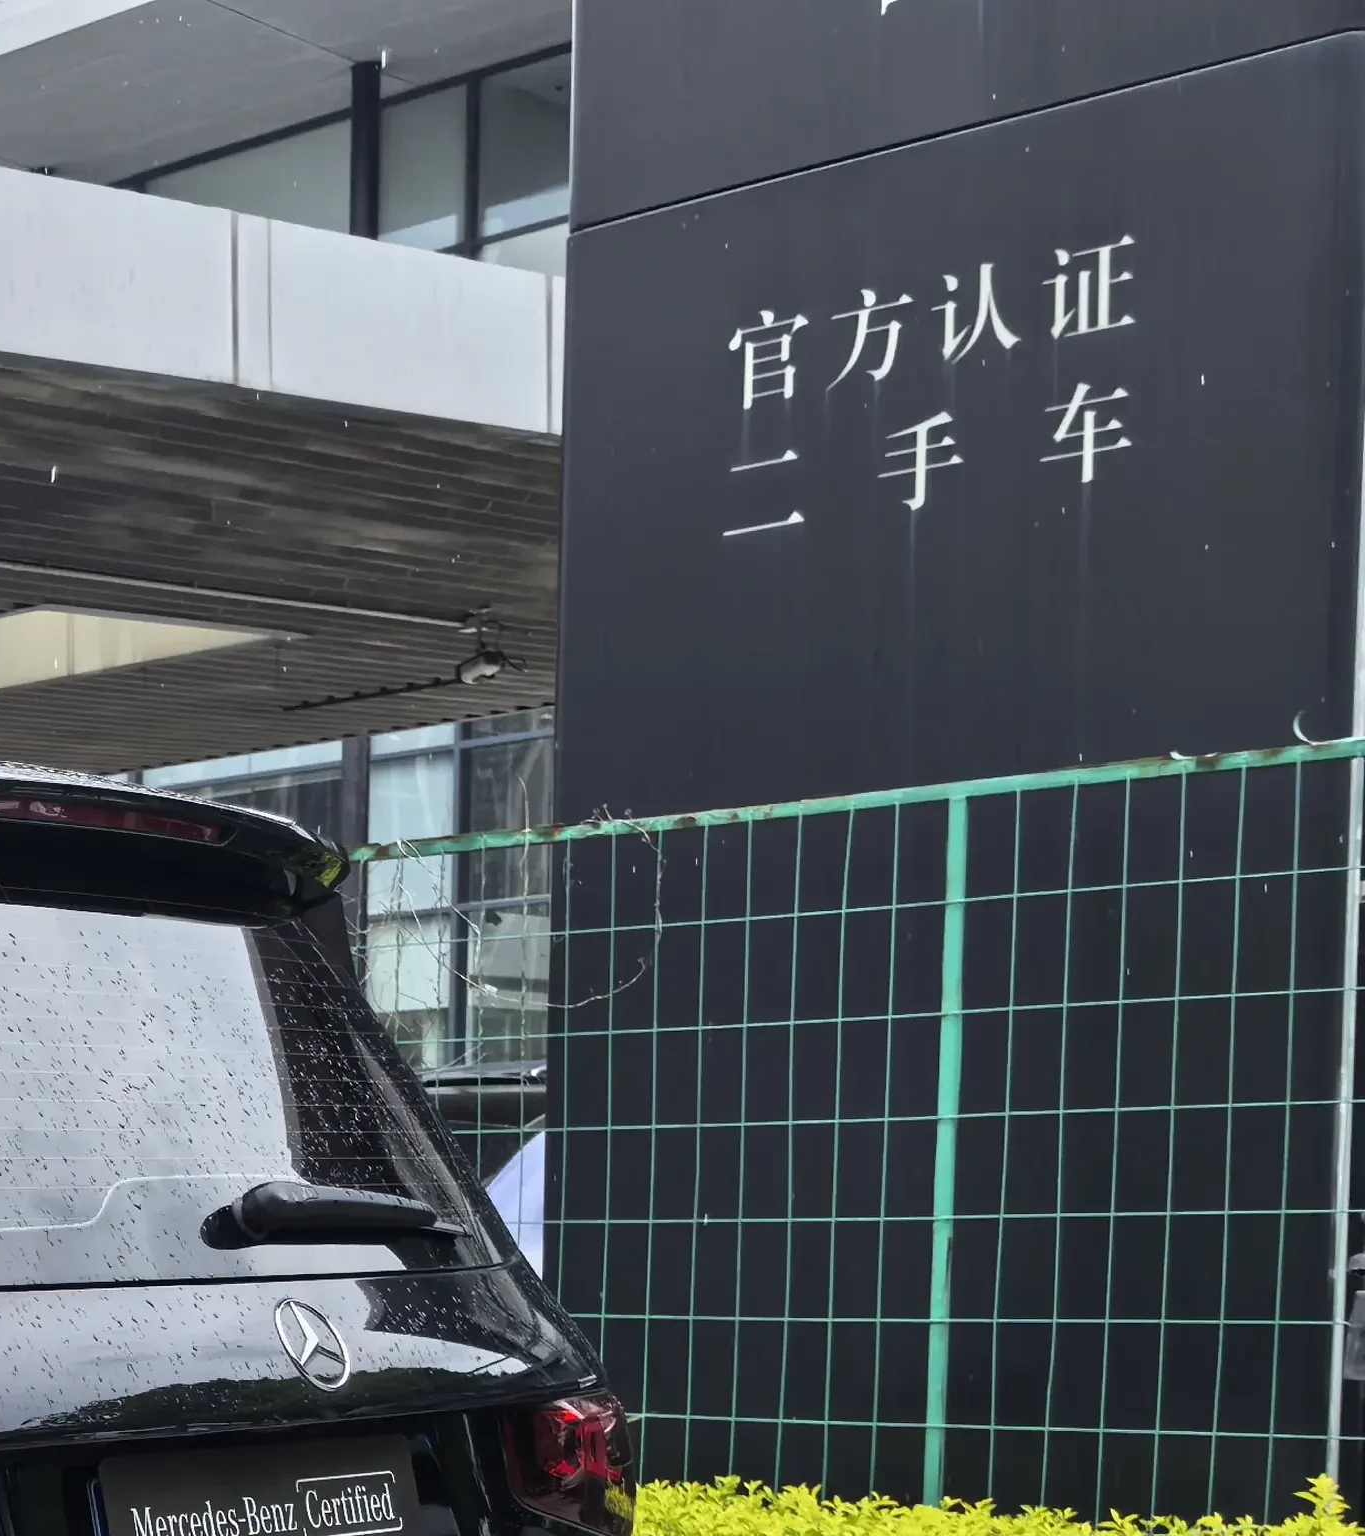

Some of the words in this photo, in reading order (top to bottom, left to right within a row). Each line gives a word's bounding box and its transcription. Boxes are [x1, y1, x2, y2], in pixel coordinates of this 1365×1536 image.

[729, 234, 1136, 410] 官方认证
[722, 382, 1134, 537] 二手车
[304, 1483, 396, 1529] Certified
